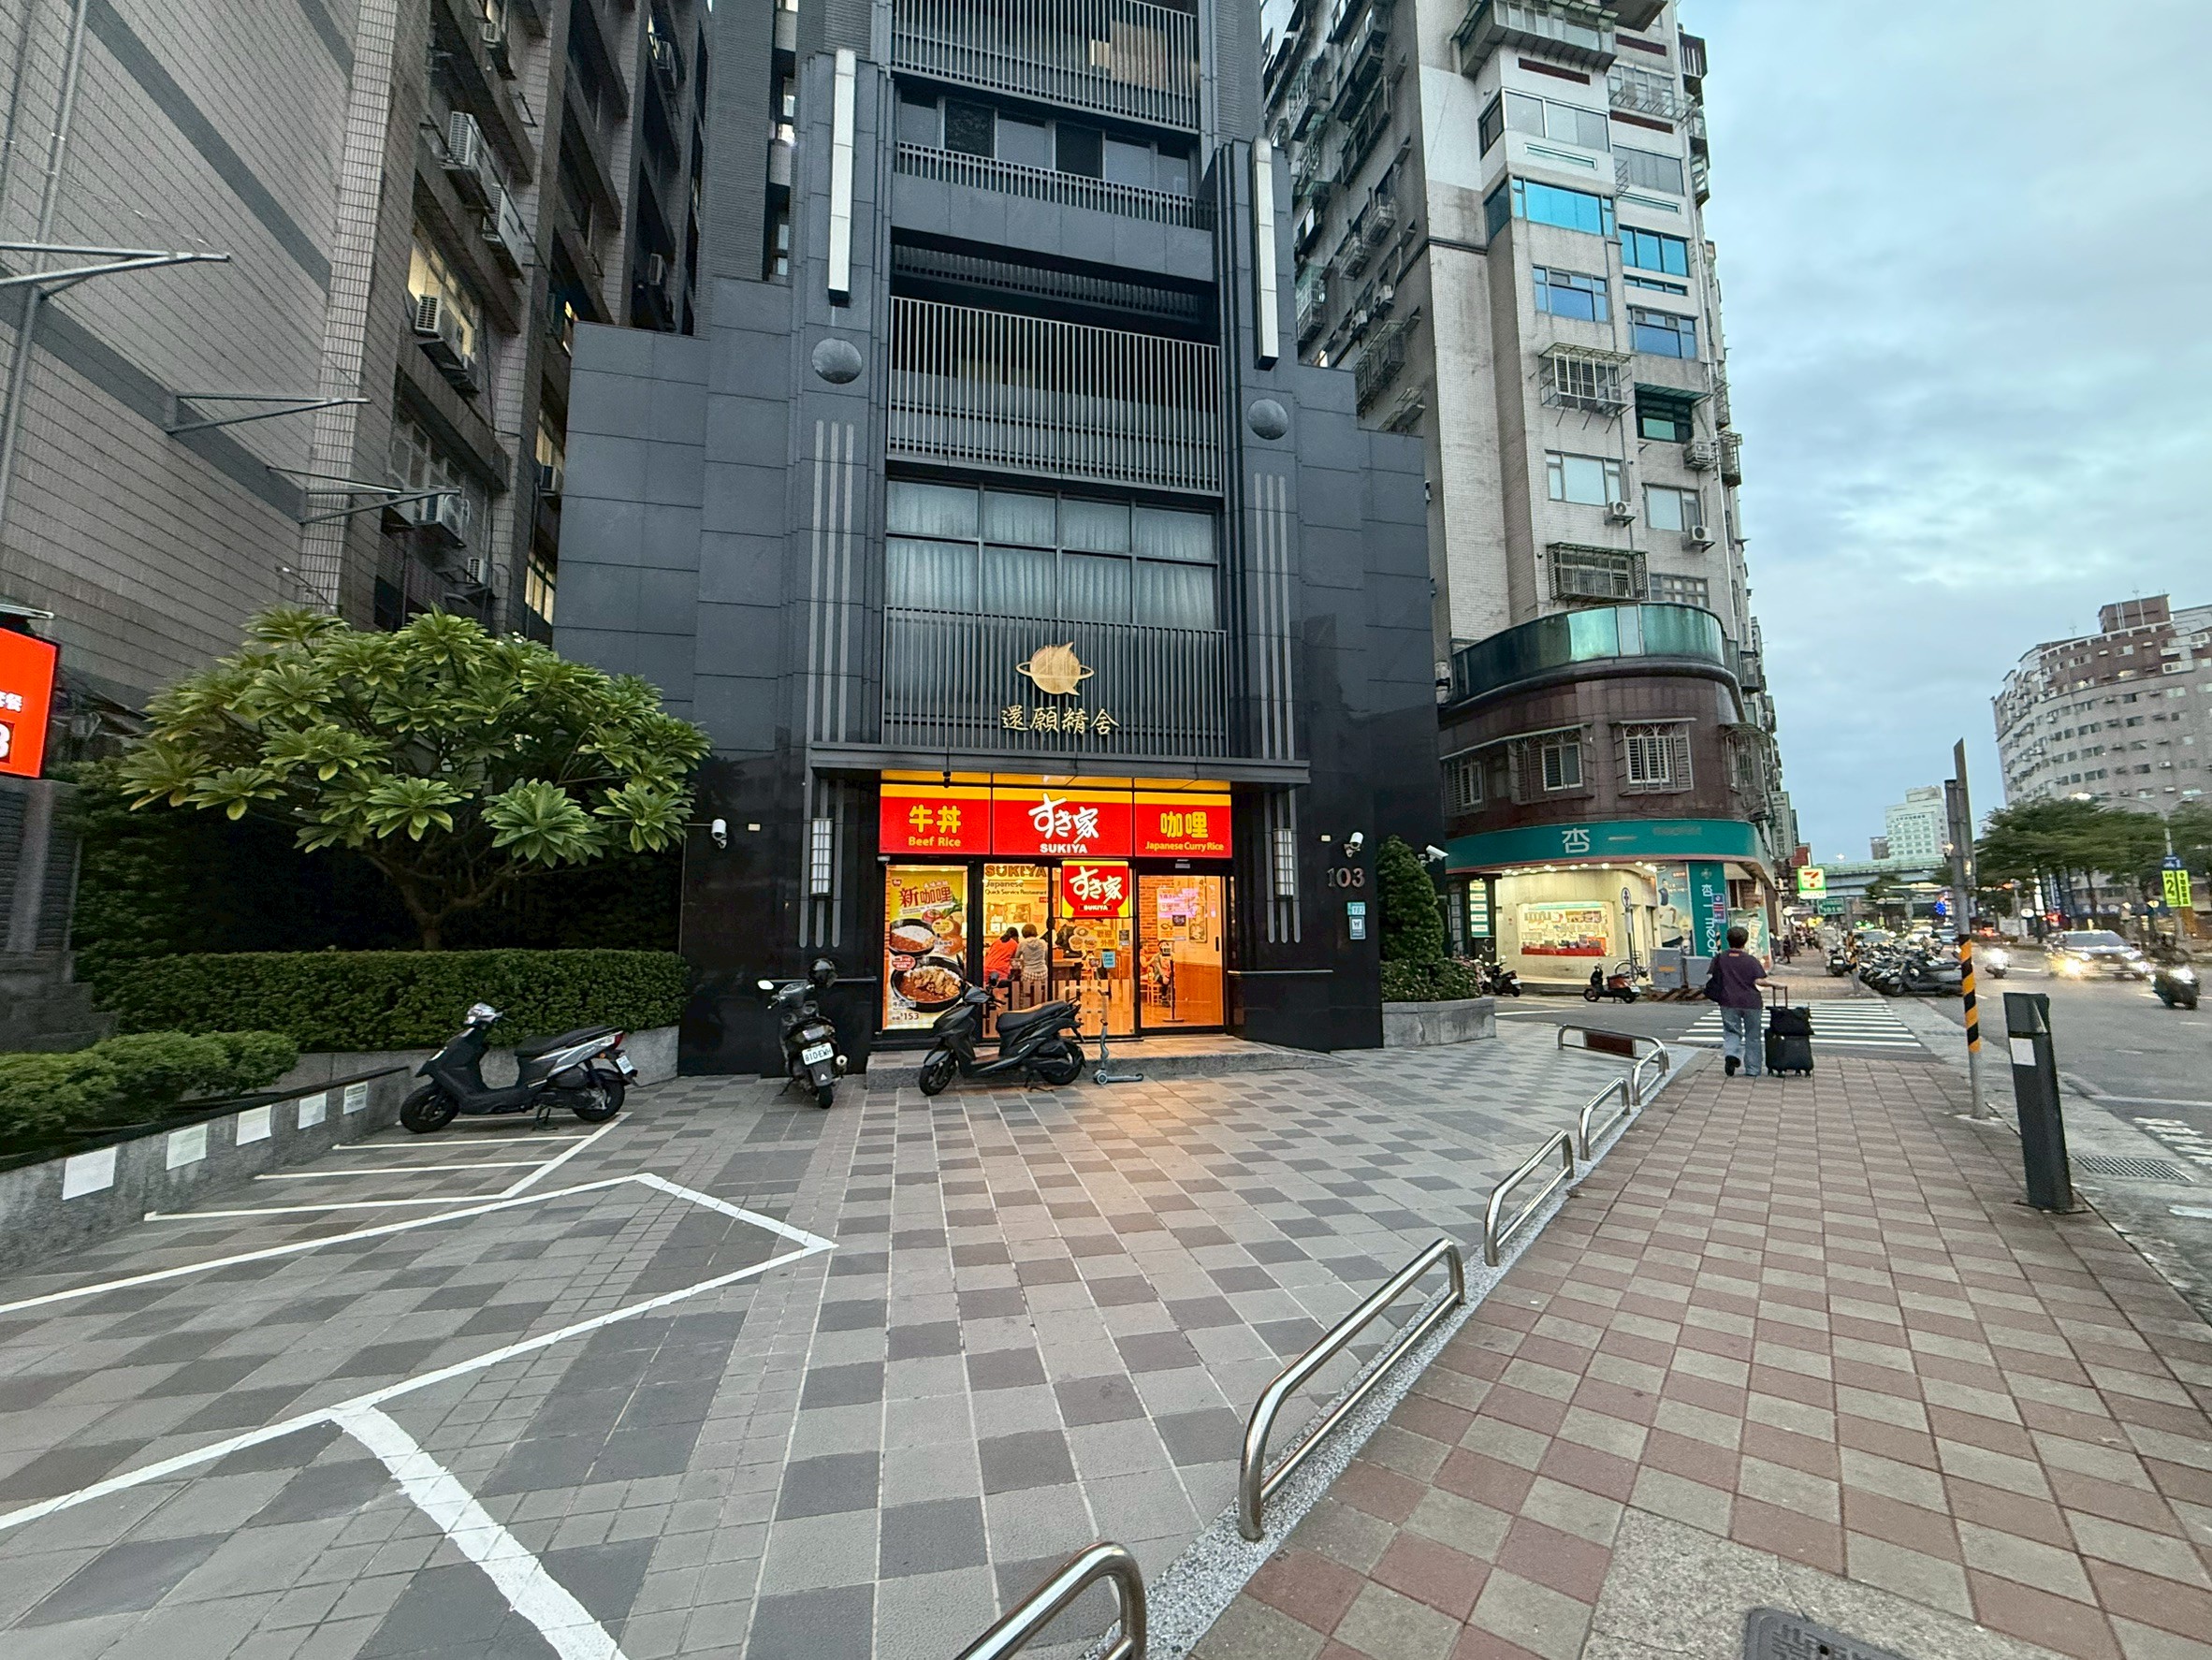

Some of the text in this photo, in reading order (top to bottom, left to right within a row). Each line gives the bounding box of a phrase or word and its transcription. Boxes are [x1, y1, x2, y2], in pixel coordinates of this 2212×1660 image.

[1001, 705, 1120, 735] 還願精舍
[909, 804, 962, 834] 牛丼
[1027, 792, 1099, 844] すき家
[1160, 810, 1209, 838] 咖哩
[908, 836, 961, 847] Beef Rice
[1040, 843, 1088, 853] SUKIYA
[1145, 841, 1224, 852] Japanese Curry Rice
[984, 865, 1047, 877] SUKIYA
[1327, 867, 1365, 887] 103
[899, 885, 952, 908] 新咖哩
[1069, 866, 1123, 904] すき家
